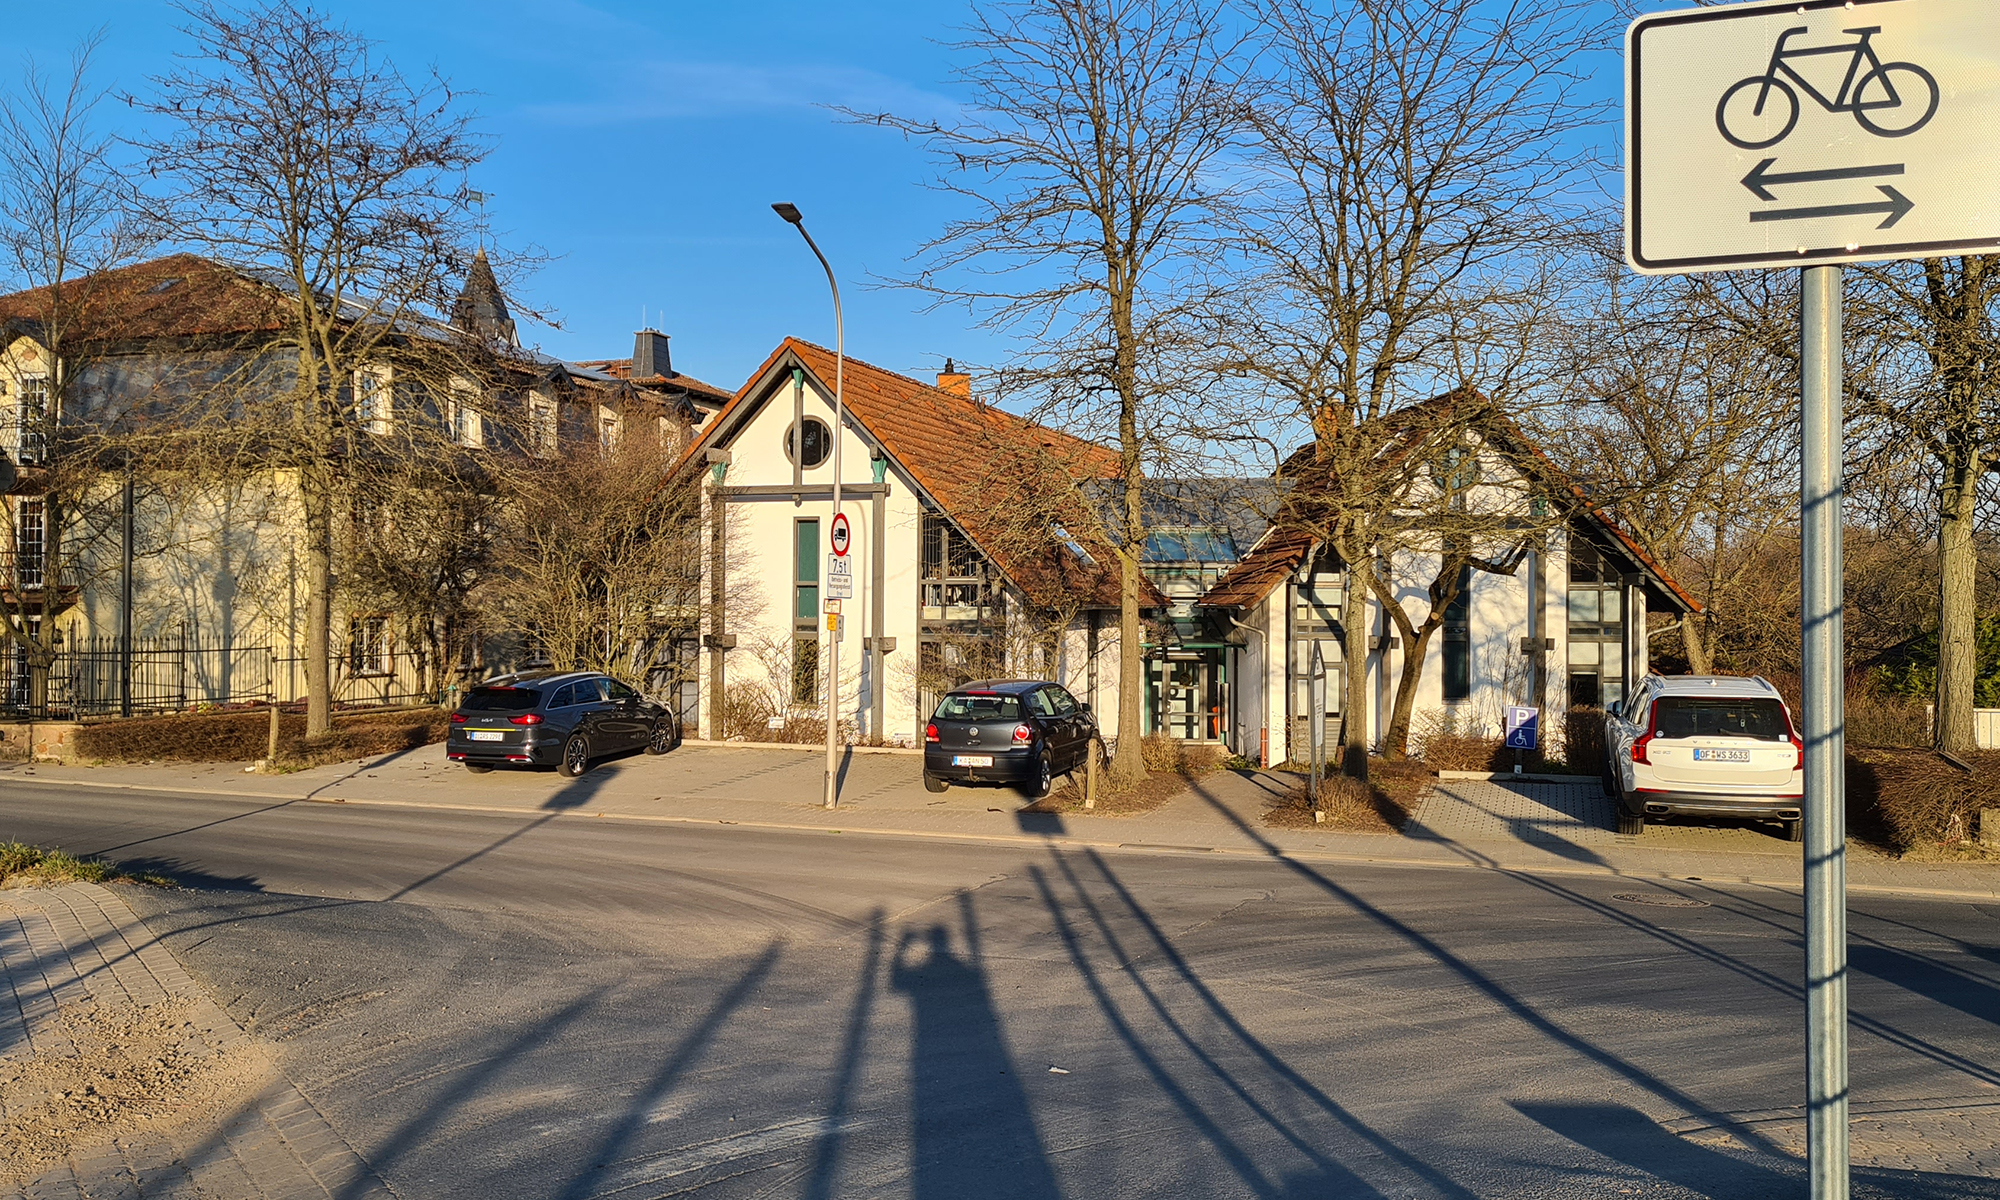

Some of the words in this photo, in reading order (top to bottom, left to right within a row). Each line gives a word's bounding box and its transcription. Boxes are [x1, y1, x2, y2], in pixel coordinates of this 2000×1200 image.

[1516, 709, 1529, 726] P
[1700, 750, 1710, 758] OF
[1716, 750, 1727, 759] WS
[1728, 751, 1748, 760] 3633
